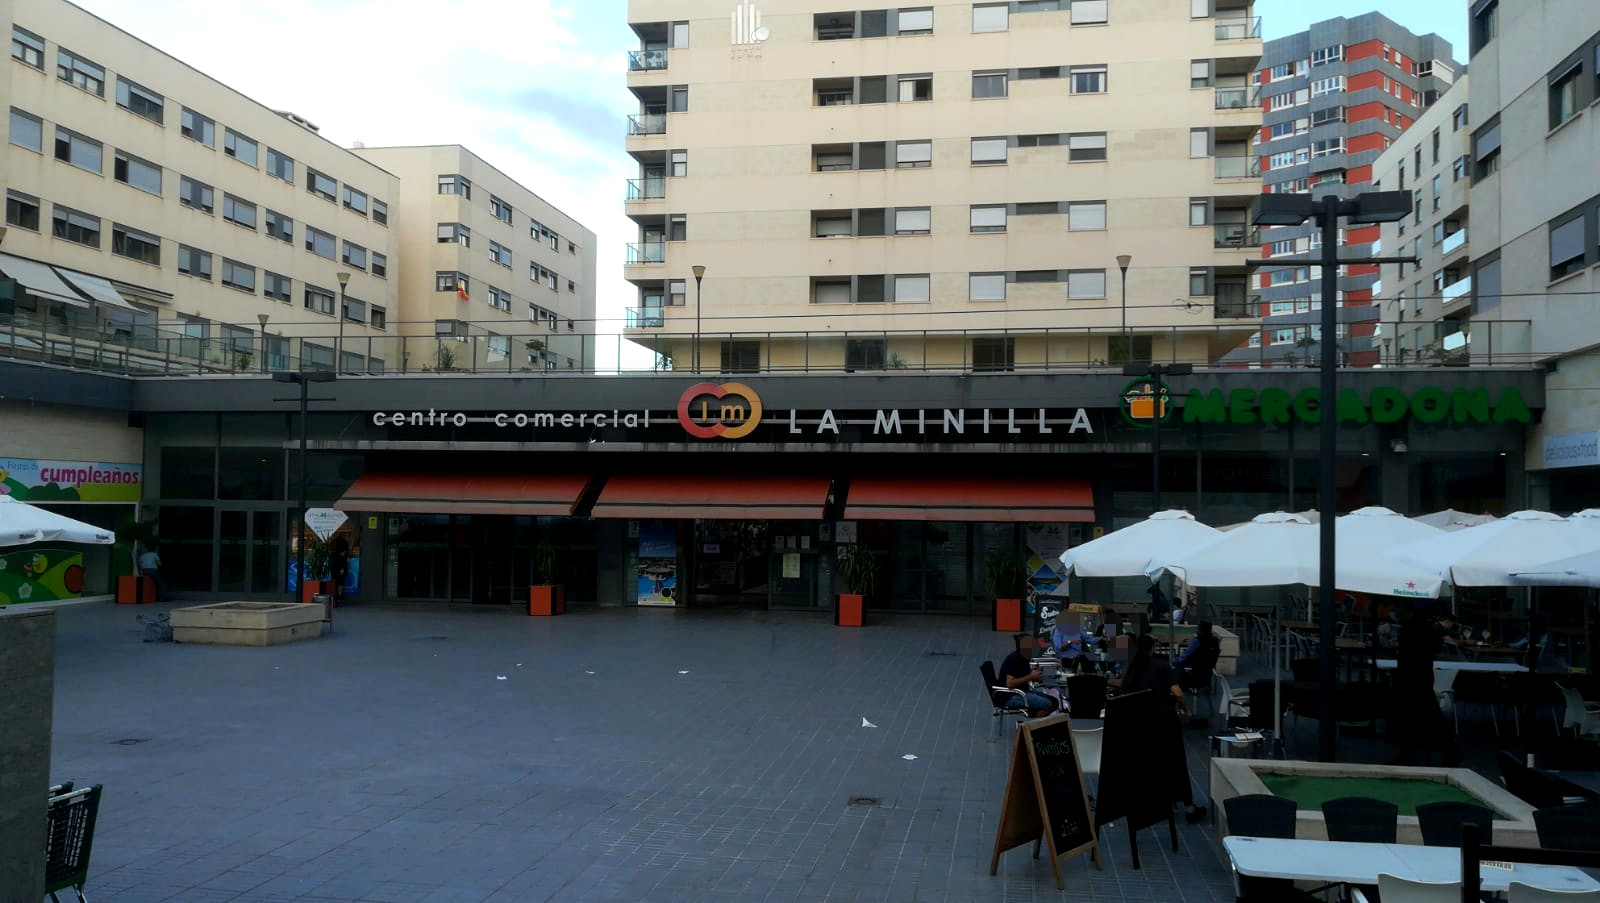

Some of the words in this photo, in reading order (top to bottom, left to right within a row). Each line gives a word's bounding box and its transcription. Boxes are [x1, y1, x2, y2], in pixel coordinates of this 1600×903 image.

[1183, 386, 1532, 424] MERCADONA
[373, 408, 467, 427] centro
[494, 408, 650, 428] comercial
[789, 408, 840, 434] LA
[873, 408, 1094, 434] MINILLA
[40, 465, 140, 488] cumpleaños
